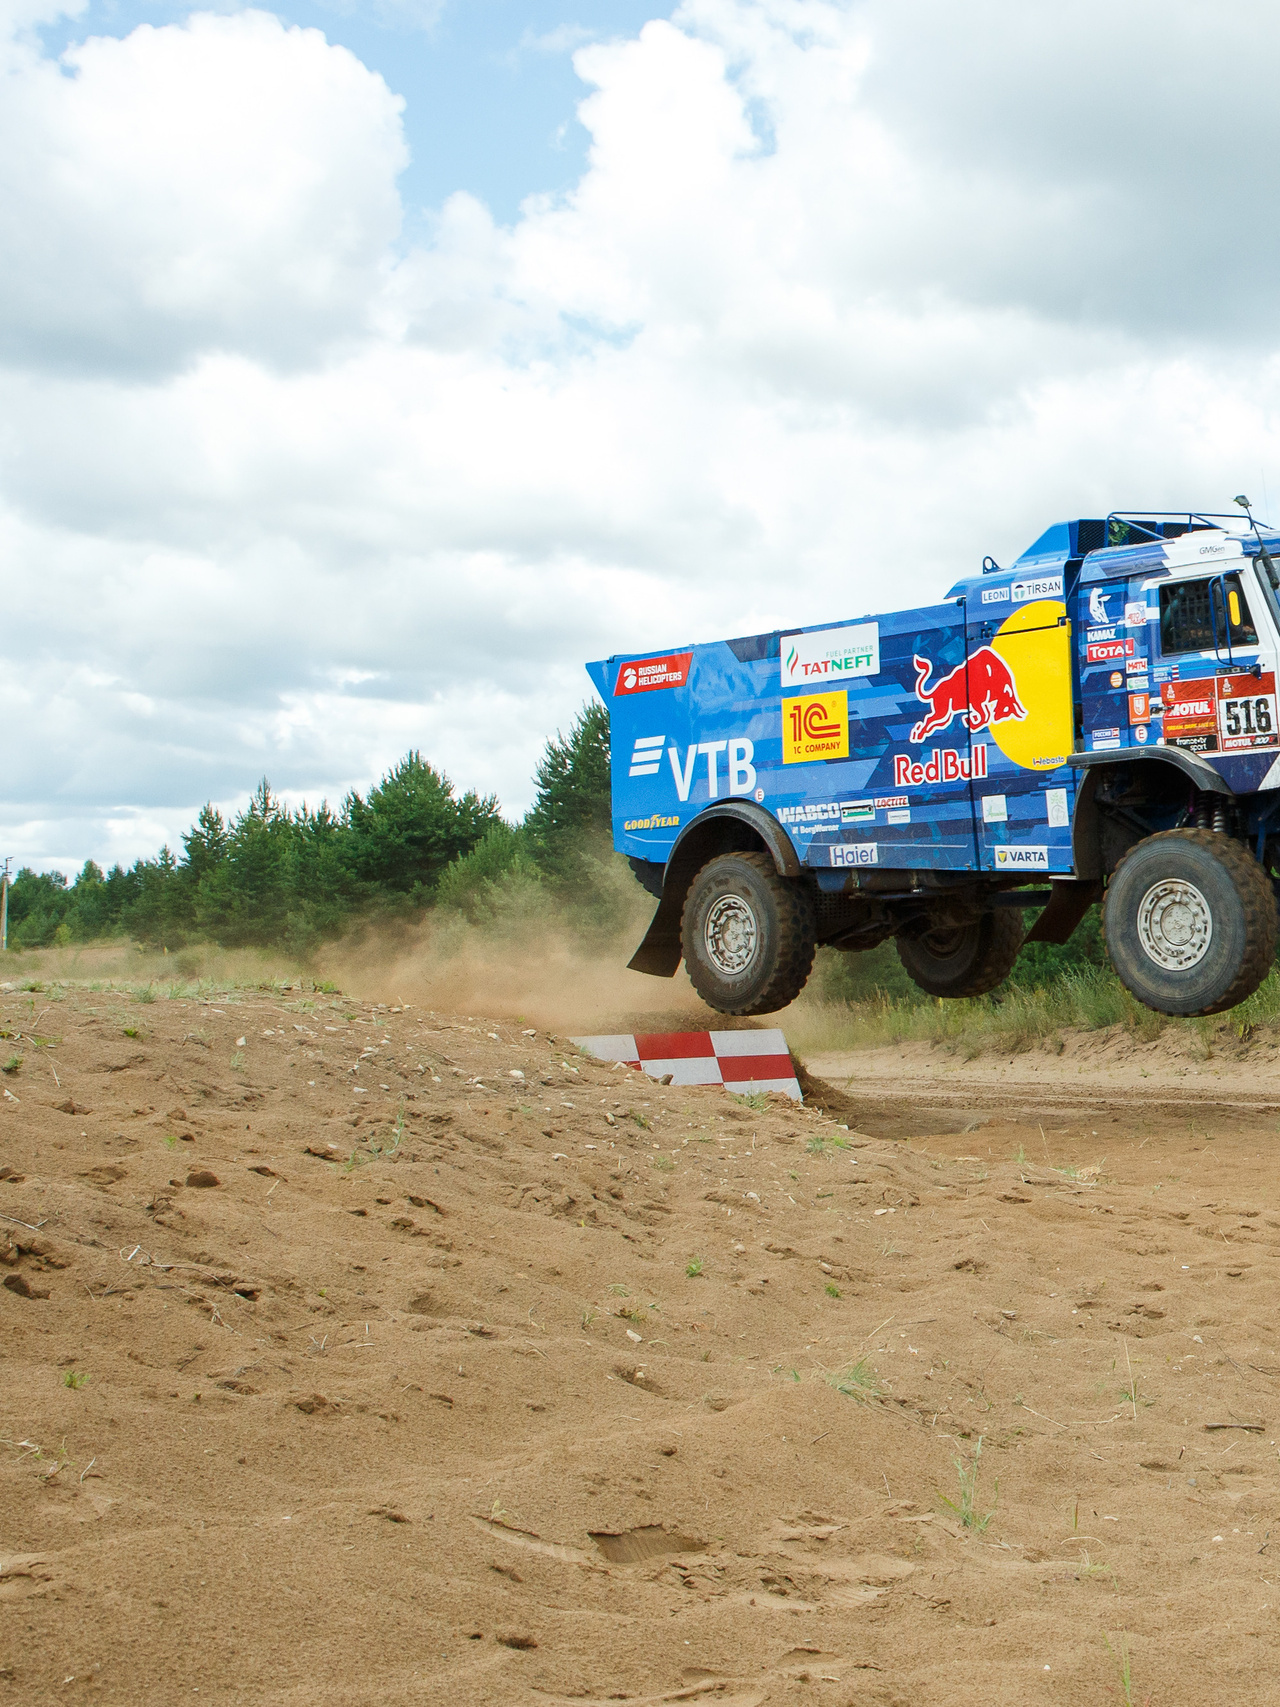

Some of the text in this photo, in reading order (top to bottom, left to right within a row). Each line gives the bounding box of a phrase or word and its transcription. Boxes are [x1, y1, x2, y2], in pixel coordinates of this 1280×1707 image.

[983, 590, 1008, 601] LEONI
[1087, 629, 1116, 642] KAMAZ
[826, 645, 874, 658] FUEL PARTNER
[1089, 645, 1133, 659] TOTAL
[638, 664, 667, 677] RUSSIAN
[801, 654, 874, 676] TATNEFT
[638, 671, 682, 687] HELICOPTERS
[1169, 701, 1210, 716] MOTUL
[1226, 698, 1272, 736] 516
[1138, 729, 1145, 739] E
[805, 741, 841, 753] COMPANY
[1190, 744, 1207, 752] sport
[1225, 738, 1252, 748] MOTUL
[896, 746, 987, 785] Red Bull
[1032, 755, 1066, 766] Webasto
[668, 737, 757, 802] VTB
[876, 797, 908, 808] LOCTITE
[776, 803, 841, 823] WABCO
[800, 824, 840, 834] BorgWarner
[833, 846, 875, 865] Haier
[1010, 851, 1046, 862] VARTA
